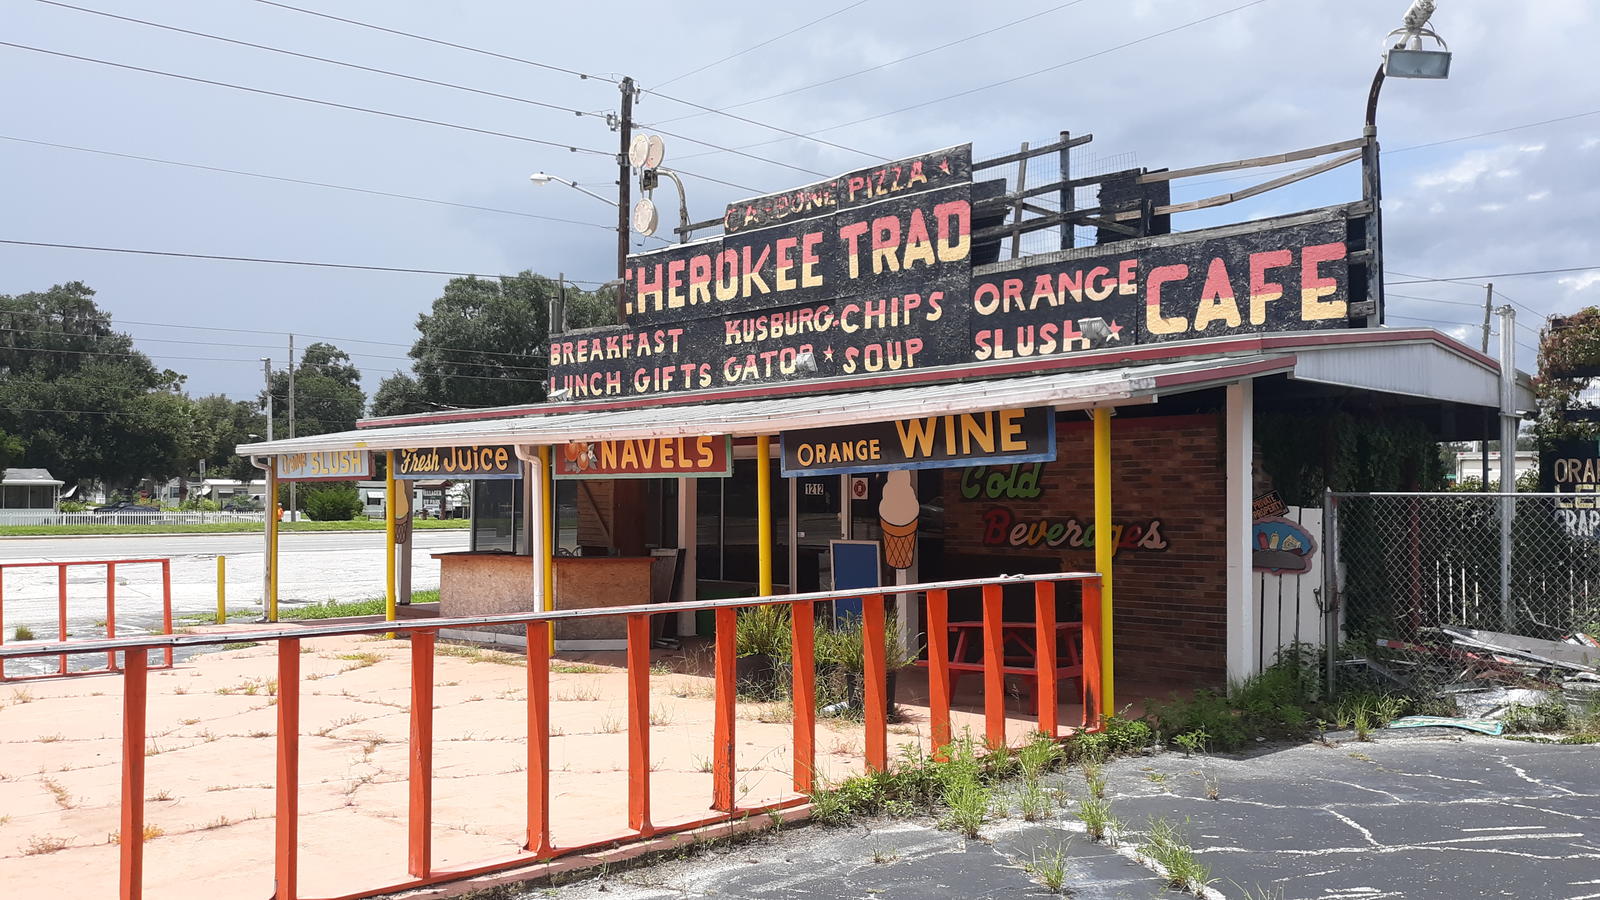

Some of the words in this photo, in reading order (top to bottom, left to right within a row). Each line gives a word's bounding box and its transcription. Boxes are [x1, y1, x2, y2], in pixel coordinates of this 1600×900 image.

[849, 161, 927, 200] PIZZA
[626, 232, 824, 315] HEROKEE
[840, 200, 971, 279] TRAD
[974, 259, 1138, 315] ORANGE
[1146, 241, 1348, 335] CAFE
[550, 329, 684, 366] BREAKFAST
[975, 319, 1091, 360] SLUSH
[634, 362, 712, 393] GIFTS
[843, 338, 924, 374] SOUP
[601, 436, 714, 469] NAVELS
[797, 439, 881, 467] ORANGE
[895, 408, 1028, 459] WINE
[311, 450, 363, 475] SLUSH
[400, 447, 440, 474] Fresh
[443, 444, 509, 472] Juice
[1554, 458, 1600, 483] ORA
[805, 484, 824, 495] 1212
[960, 462, 1041, 499] Cold
